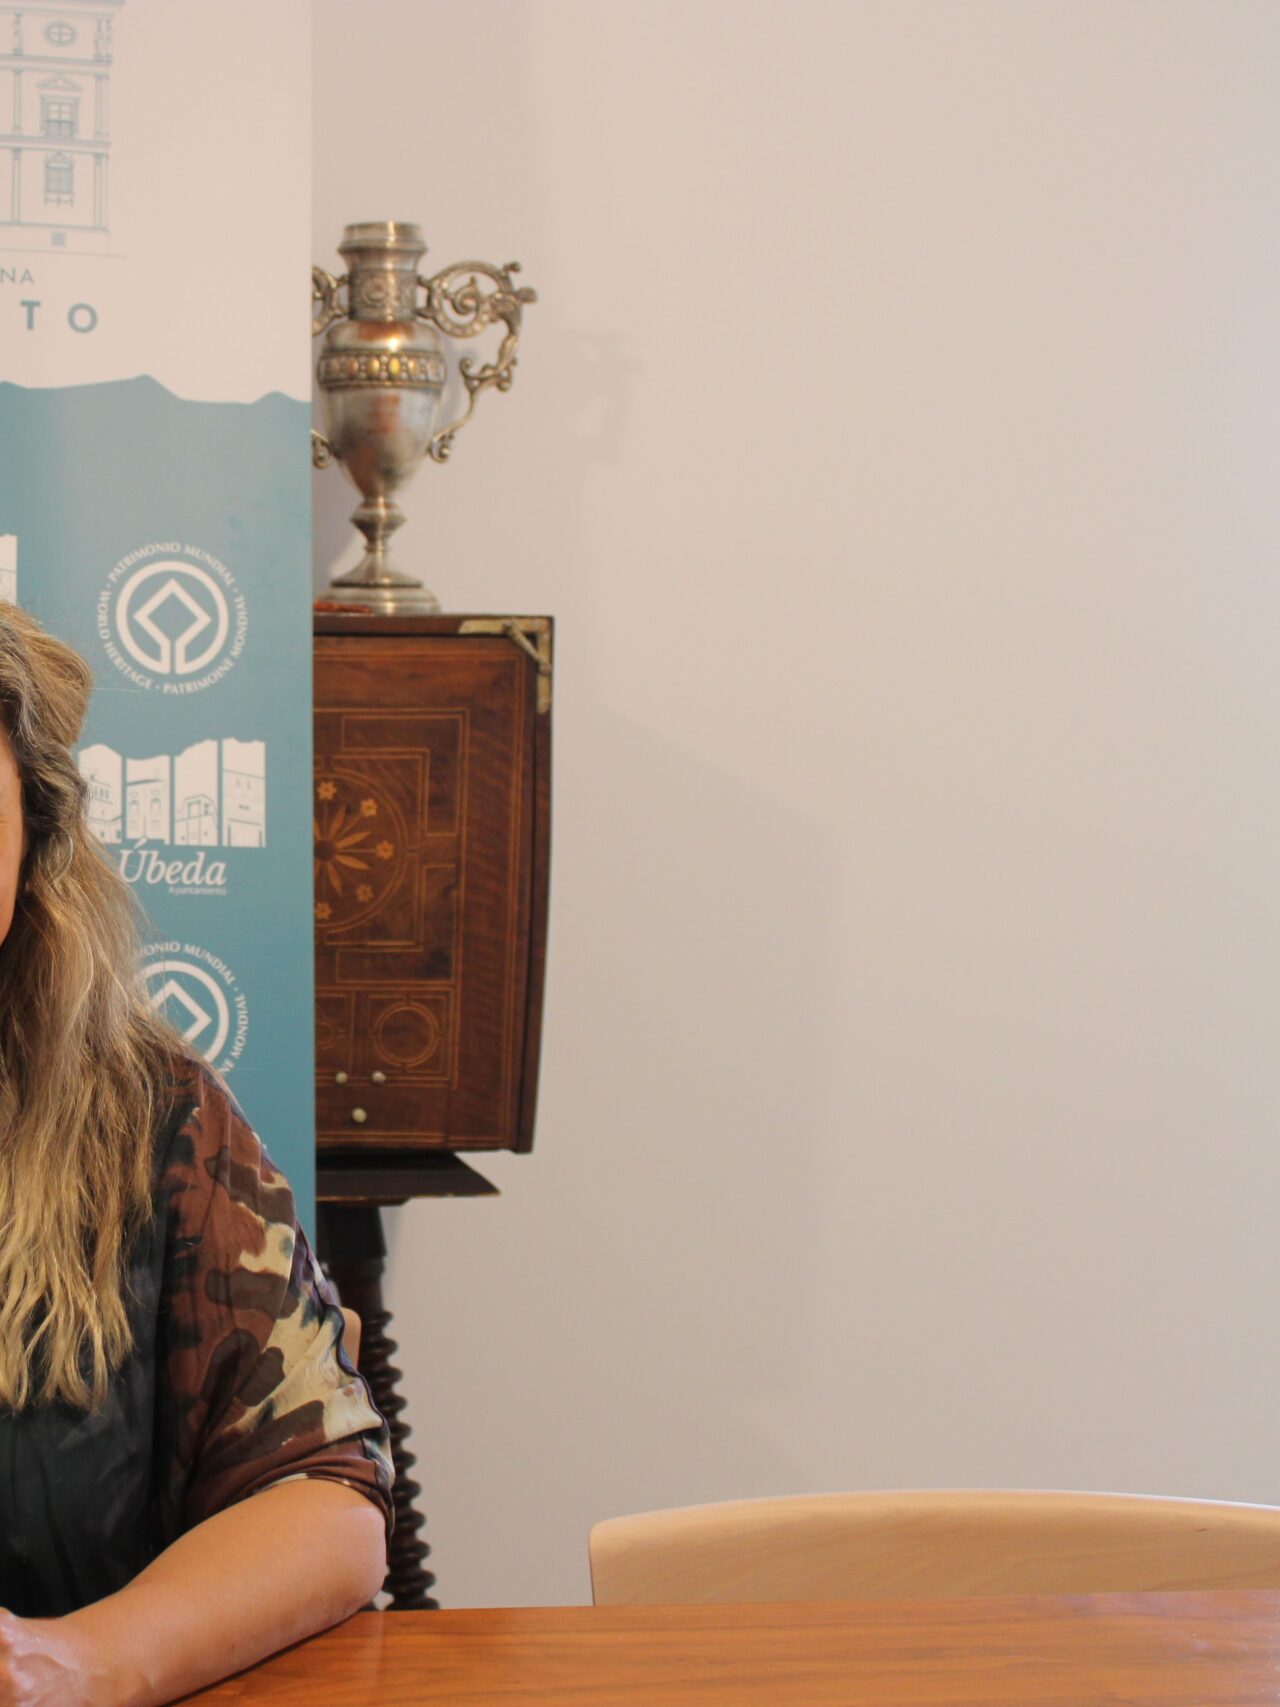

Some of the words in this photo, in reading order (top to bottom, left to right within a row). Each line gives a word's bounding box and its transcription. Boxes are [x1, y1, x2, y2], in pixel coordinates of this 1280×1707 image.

[108, 541, 181, 583] PATRIMONIO
[184, 543, 236, 586] MUNDIAL
[97, 590, 112, 640] WORLD
[103, 641, 153, 690] HERITAGE
[163, 657, 235, 695] PATRIMOINE
[230, 594, 248, 658] MONDIAL
[119, 837, 227, 886] Úbeda
[184, 944, 236, 984] MUNDIAL
[231, 995, 248, 1059] MONDIAL
